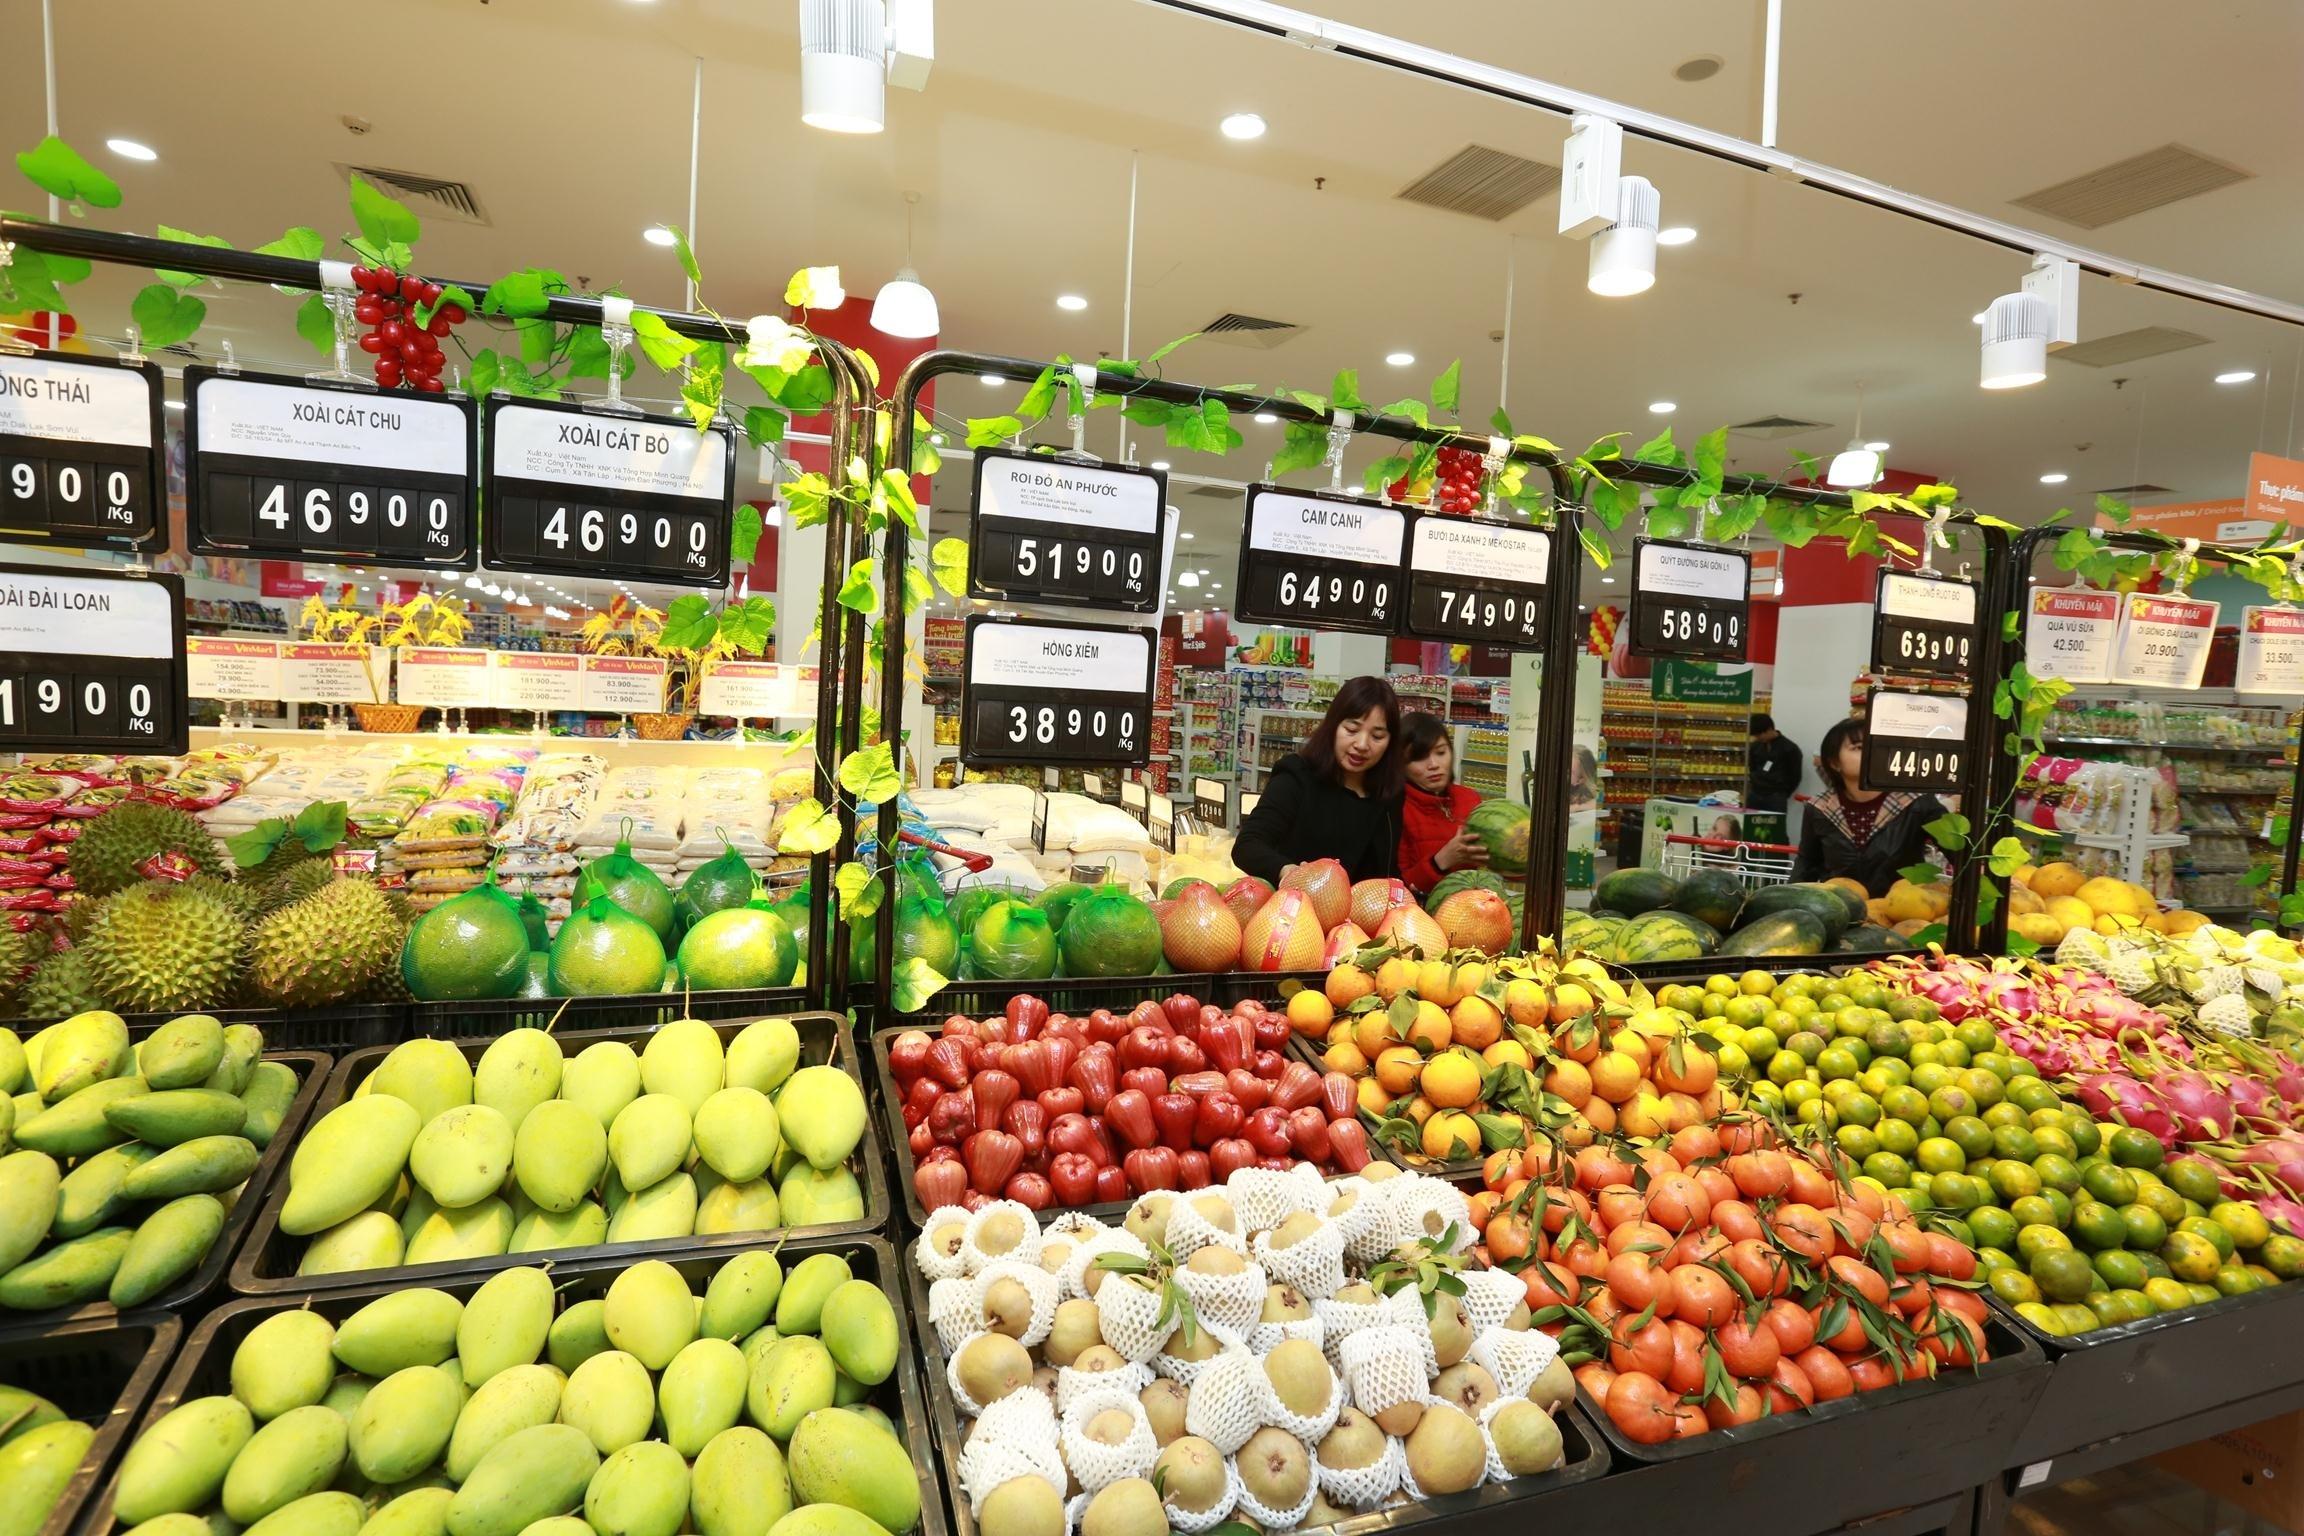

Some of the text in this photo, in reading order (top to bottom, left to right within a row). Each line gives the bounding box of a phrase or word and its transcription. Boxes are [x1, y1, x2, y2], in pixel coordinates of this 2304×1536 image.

[44, 378, 90, 404] THÁI
[292, 401, 401, 431] XOÀI CÁT CHU
[558, 423, 600, 447] XOÀI
[605, 427, 640, 451] CÁT
[1011, 472, 1118, 497] ROI ĐỎ AN PHƯỚC
[107, 506, 133, 524] /Kg
[1301, 508, 1362, 529] CAM CANH
[427, 530, 449, 547] /Kg
[1449, 532, 1459, 542] DA
[1460, 534, 1481, 545] XANH
[1482, 537, 1487, 546] 2
[1487, 538, 1526, 551] MEKOSTAR
[686, 552, 706, 567] /Kg
[1126, 578, 1142, 593] /Kg
[29, 587, 58, 609] ĐÀI
[63, 593, 110, 611] LOAN
[1371, 607, 1385, 620] /Kg
[1522, 623, 1535, 635] /Kg
[234, 643, 274, 654] VinMart
[1727, 636, 1738, 648] /Kg
[2053, 639, 2084, 651] 42.500
[2145, 644, 2178, 657] 20.900
[2265, 652, 2293, 663] 33.500
[541, 657, 575, 667] VinMart
[625, 661, 659, 671] VinMart
[606, 680, 632, 688] 83.900
[604, 695, 633, 703] 112.900
[129, 718, 154, 733] /Kg
[1117, 738, 1134, 751] /Kg
